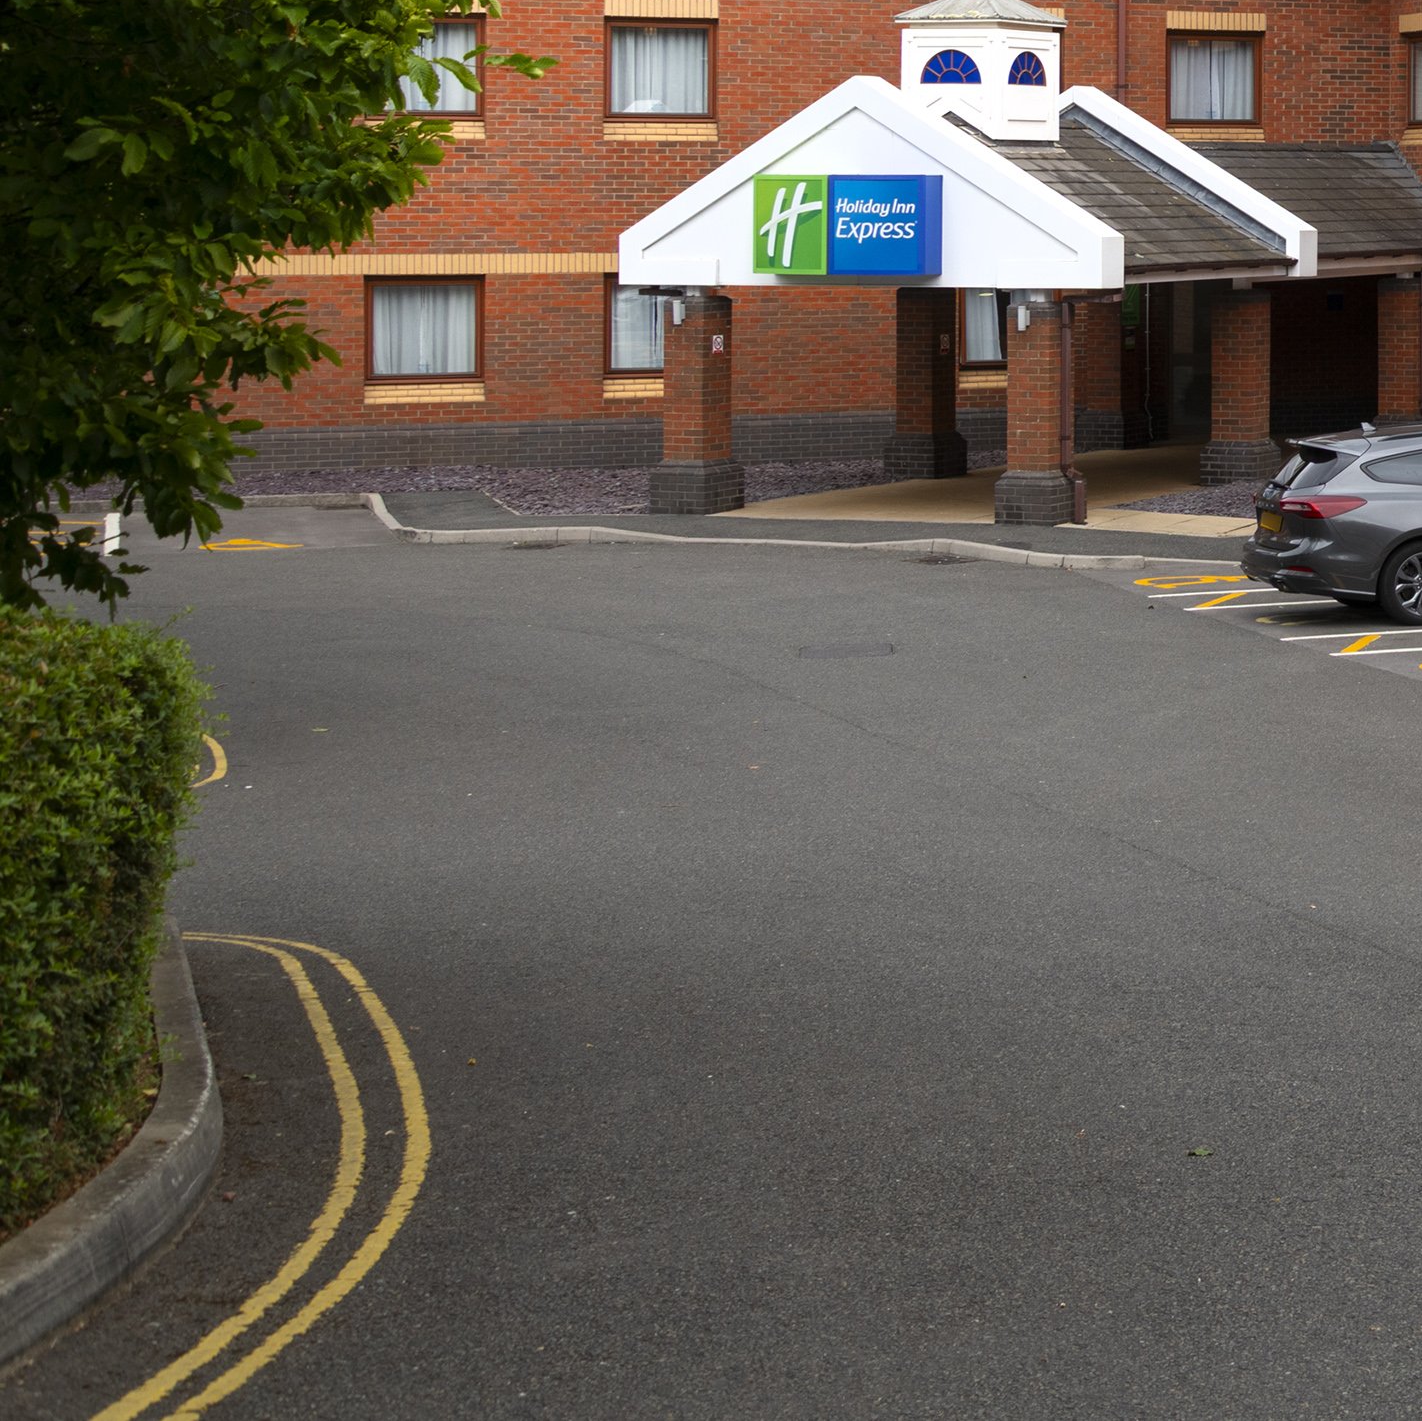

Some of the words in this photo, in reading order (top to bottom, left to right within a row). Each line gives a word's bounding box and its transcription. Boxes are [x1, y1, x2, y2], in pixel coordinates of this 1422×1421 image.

[835, 198, 892, 217] Holiday
[891, 198, 916, 214] Inn
[835, 217, 916, 244] Express
